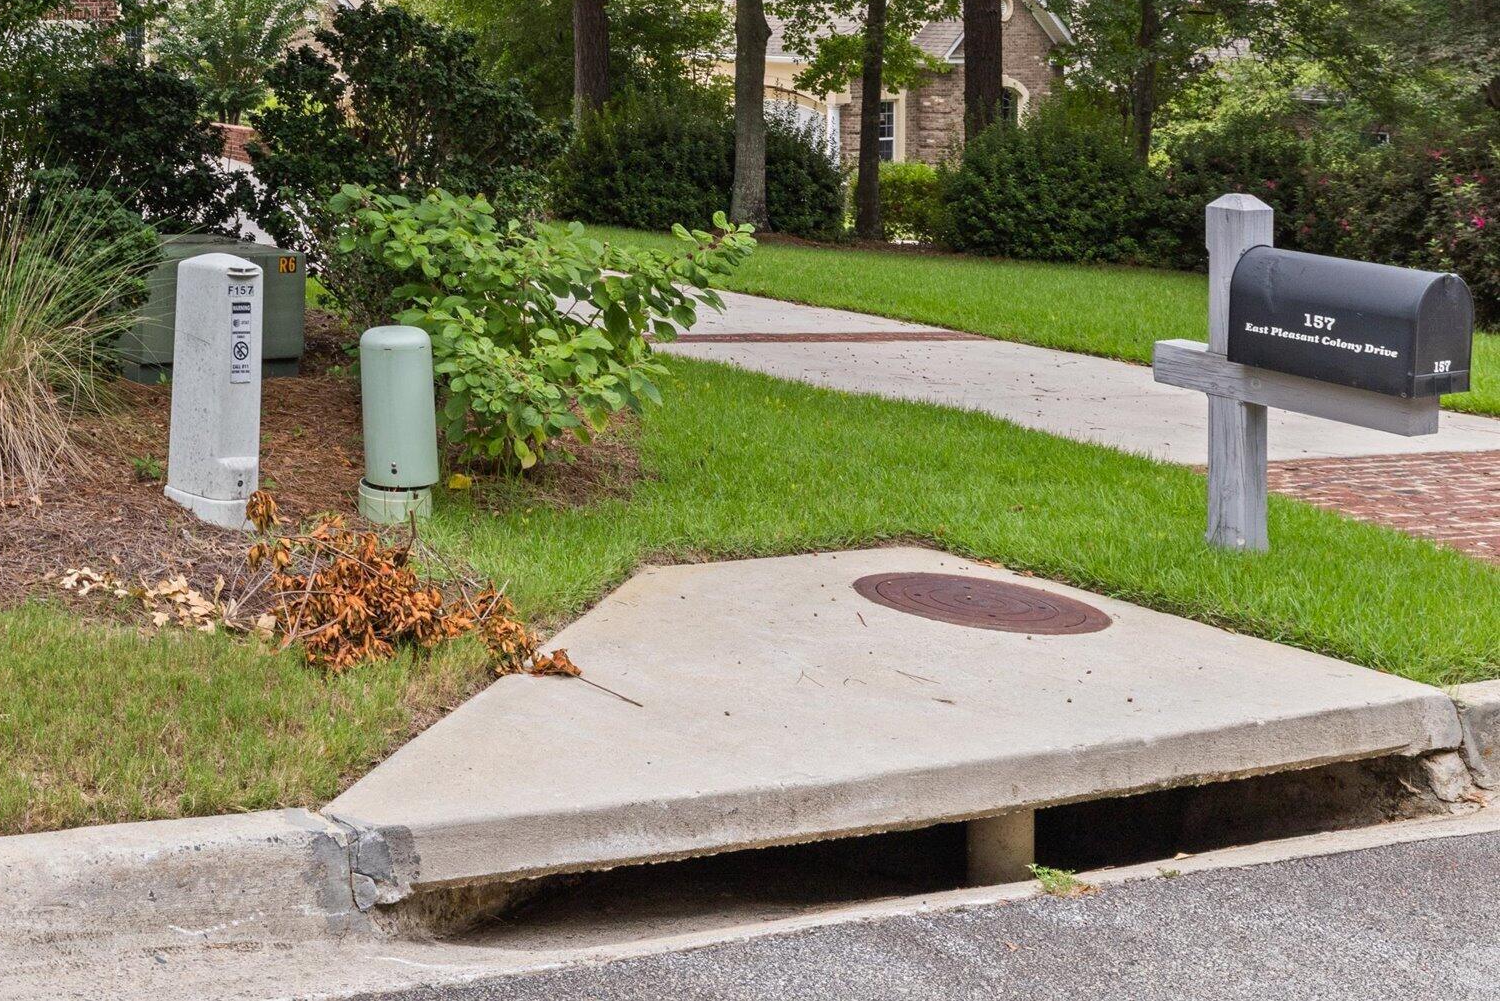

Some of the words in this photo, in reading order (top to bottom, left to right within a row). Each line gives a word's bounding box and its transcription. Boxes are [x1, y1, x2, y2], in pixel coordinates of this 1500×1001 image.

[279, 257, 296, 273] R6
[228, 286, 253, 295] F157
[1304, 313, 1336, 331] 157
[1245, 322, 1269, 335] East
[1270, 326, 1320, 344] Pleasant
[1321, 336, 1362, 353] Colony
[1364, 343, 1398, 358] Drive
[1434, 360, 1451, 373] 157
